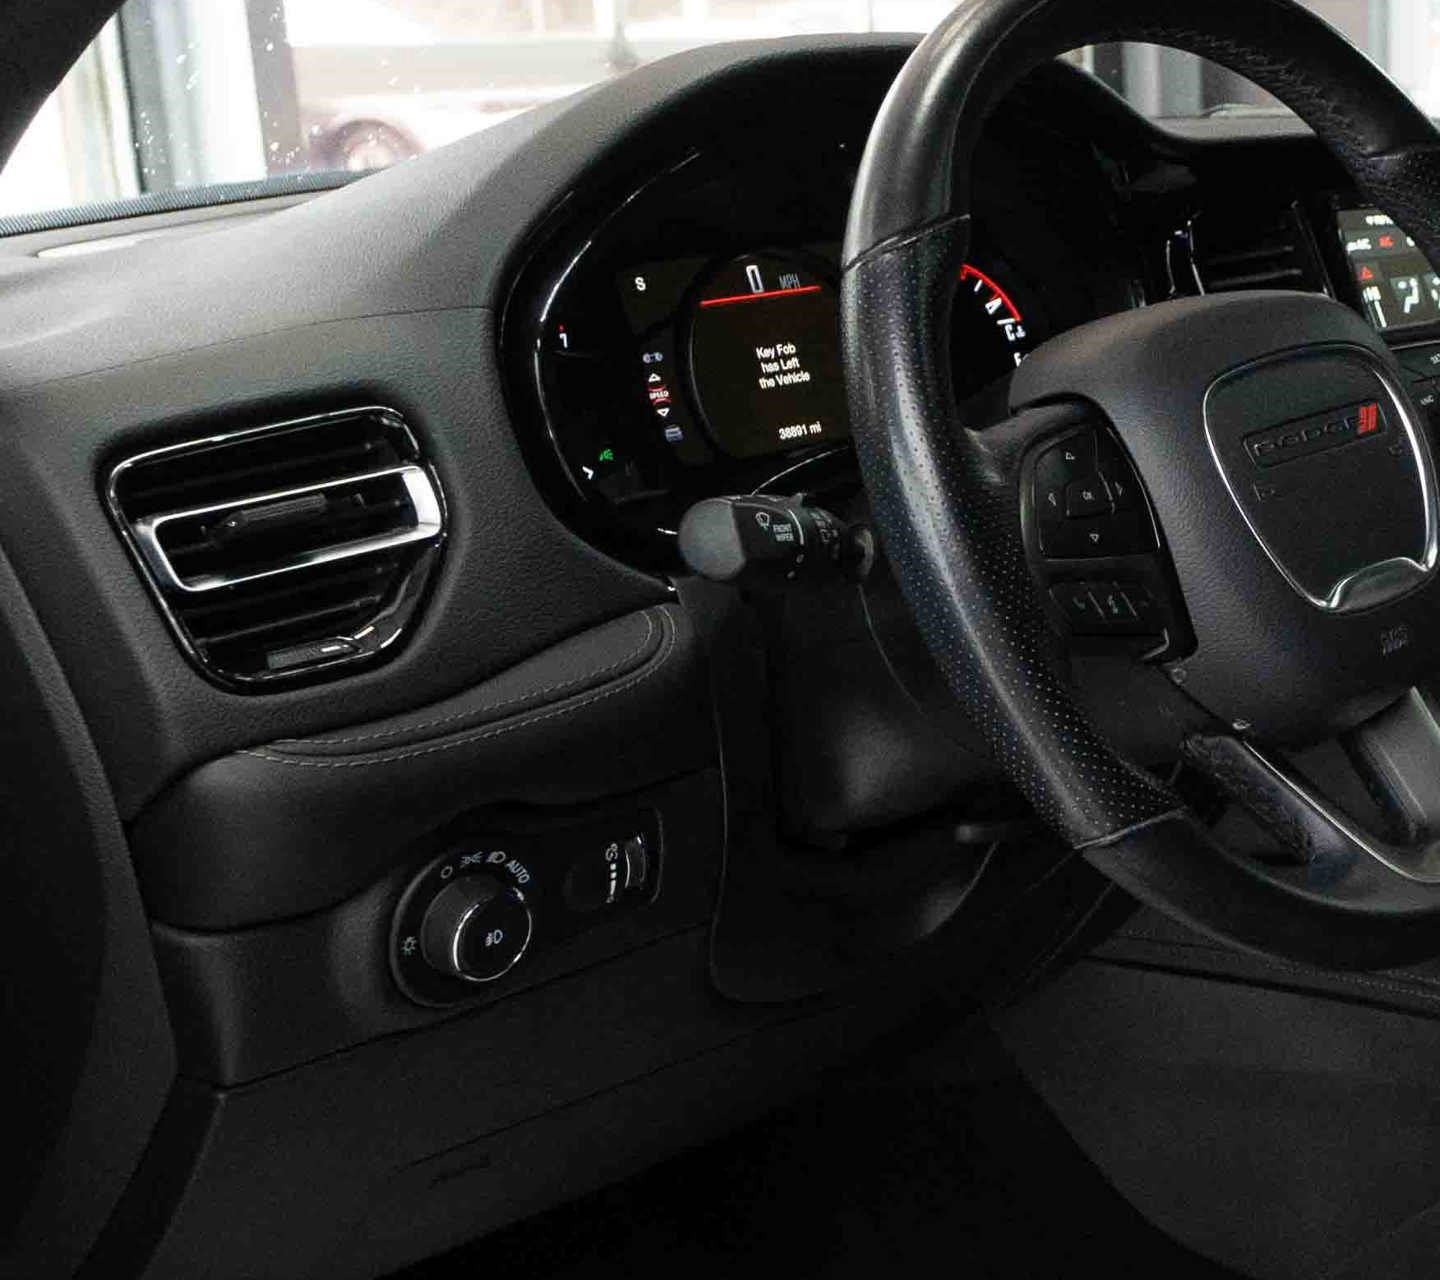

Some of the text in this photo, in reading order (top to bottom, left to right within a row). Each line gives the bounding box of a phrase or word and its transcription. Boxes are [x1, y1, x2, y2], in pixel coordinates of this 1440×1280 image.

[634, 276, 647, 292] S
[746, 265, 801, 294] 0 MPH
[755, 342, 797, 360] Key Fob
[760, 356, 800, 374] has Left
[758, 370, 811, 389] the Vehicle
[809, 420, 822, 434] mi
[505, 858, 531, 884] AUTO
